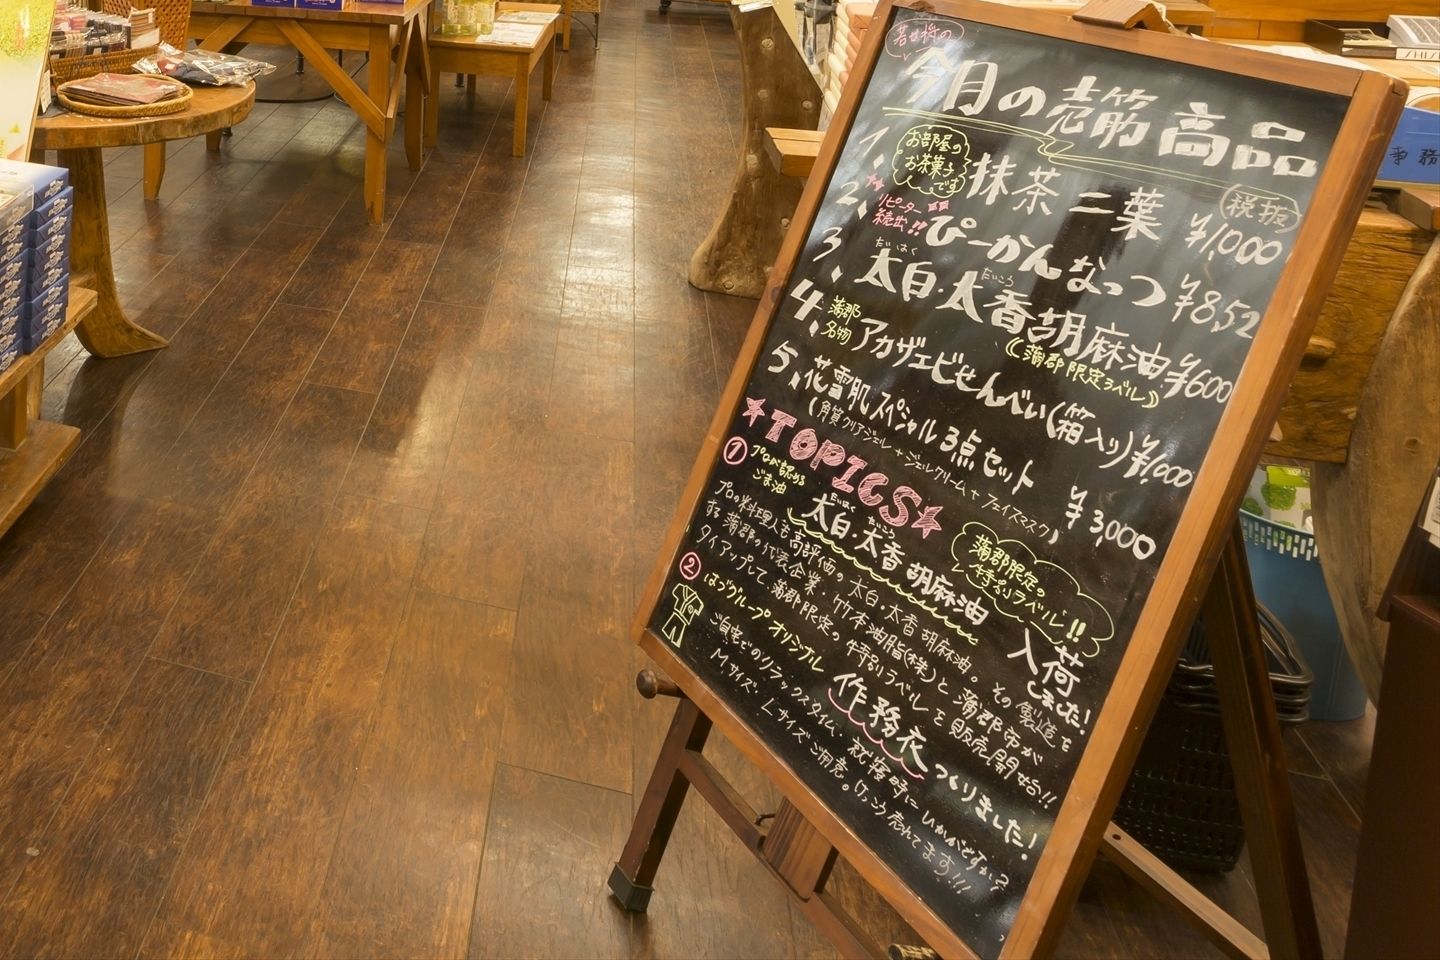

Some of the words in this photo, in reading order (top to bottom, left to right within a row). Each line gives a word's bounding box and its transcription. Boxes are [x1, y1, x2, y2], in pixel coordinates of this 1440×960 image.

[906, 129, 962, 153] お部屋の
[905, 153, 955, 177] お茶菓子
[933, 177, 960, 192] です
[878, 193, 922, 214] リピーター
[827, 295, 861, 326] 蒲郡
[820, 320, 852, 345] 名物
[1164, 353, 1233, 403] ¥600
[753, 468, 787, 495] ごま油
[765, 409, 923, 527] TOPICS
[1007, 628, 1084, 698] 入荷
[833, 672, 929, 773] 作務衣
